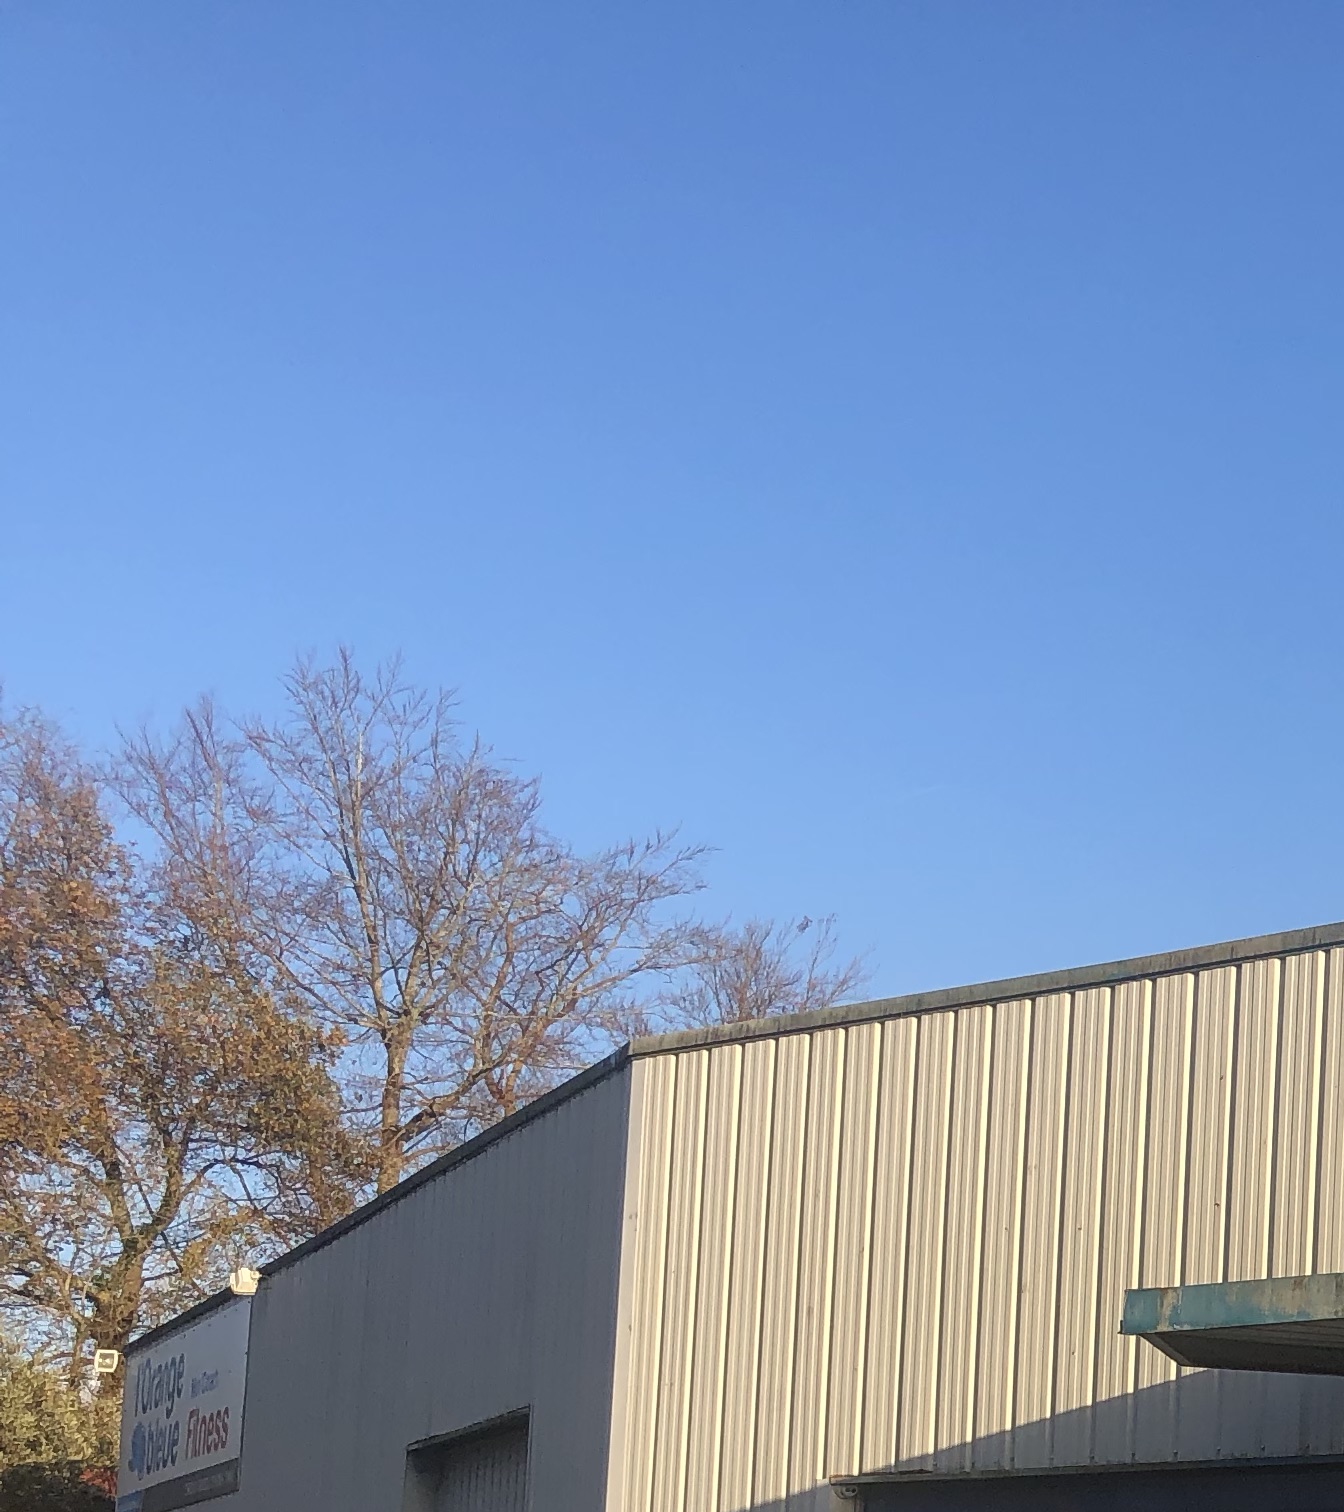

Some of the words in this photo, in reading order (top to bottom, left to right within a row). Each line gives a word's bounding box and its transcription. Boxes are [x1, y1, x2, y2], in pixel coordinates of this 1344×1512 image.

[135, 1353, 185, 1419] l'Orange
[147, 1417, 180, 1475] bleue
[184, 1406, 230, 1459] Fitness
